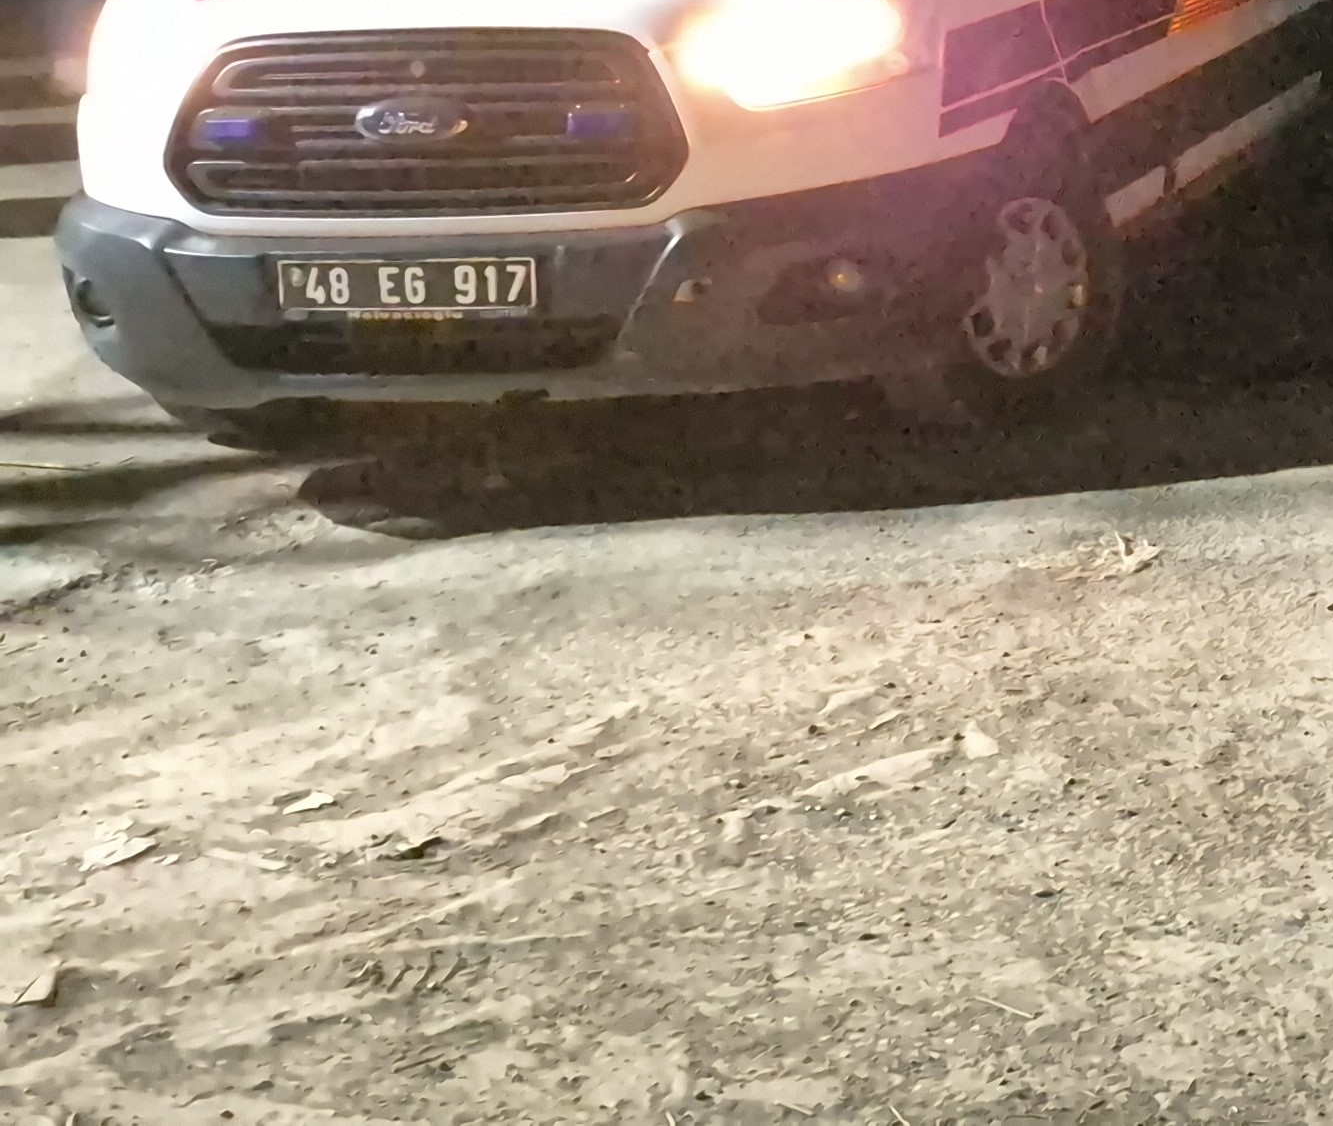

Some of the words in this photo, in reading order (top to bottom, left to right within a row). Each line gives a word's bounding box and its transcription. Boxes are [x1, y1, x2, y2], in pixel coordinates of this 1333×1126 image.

[306, 267, 350, 304] 48
[378, 266, 426, 304] EG
[454, 265, 527, 304] 917
